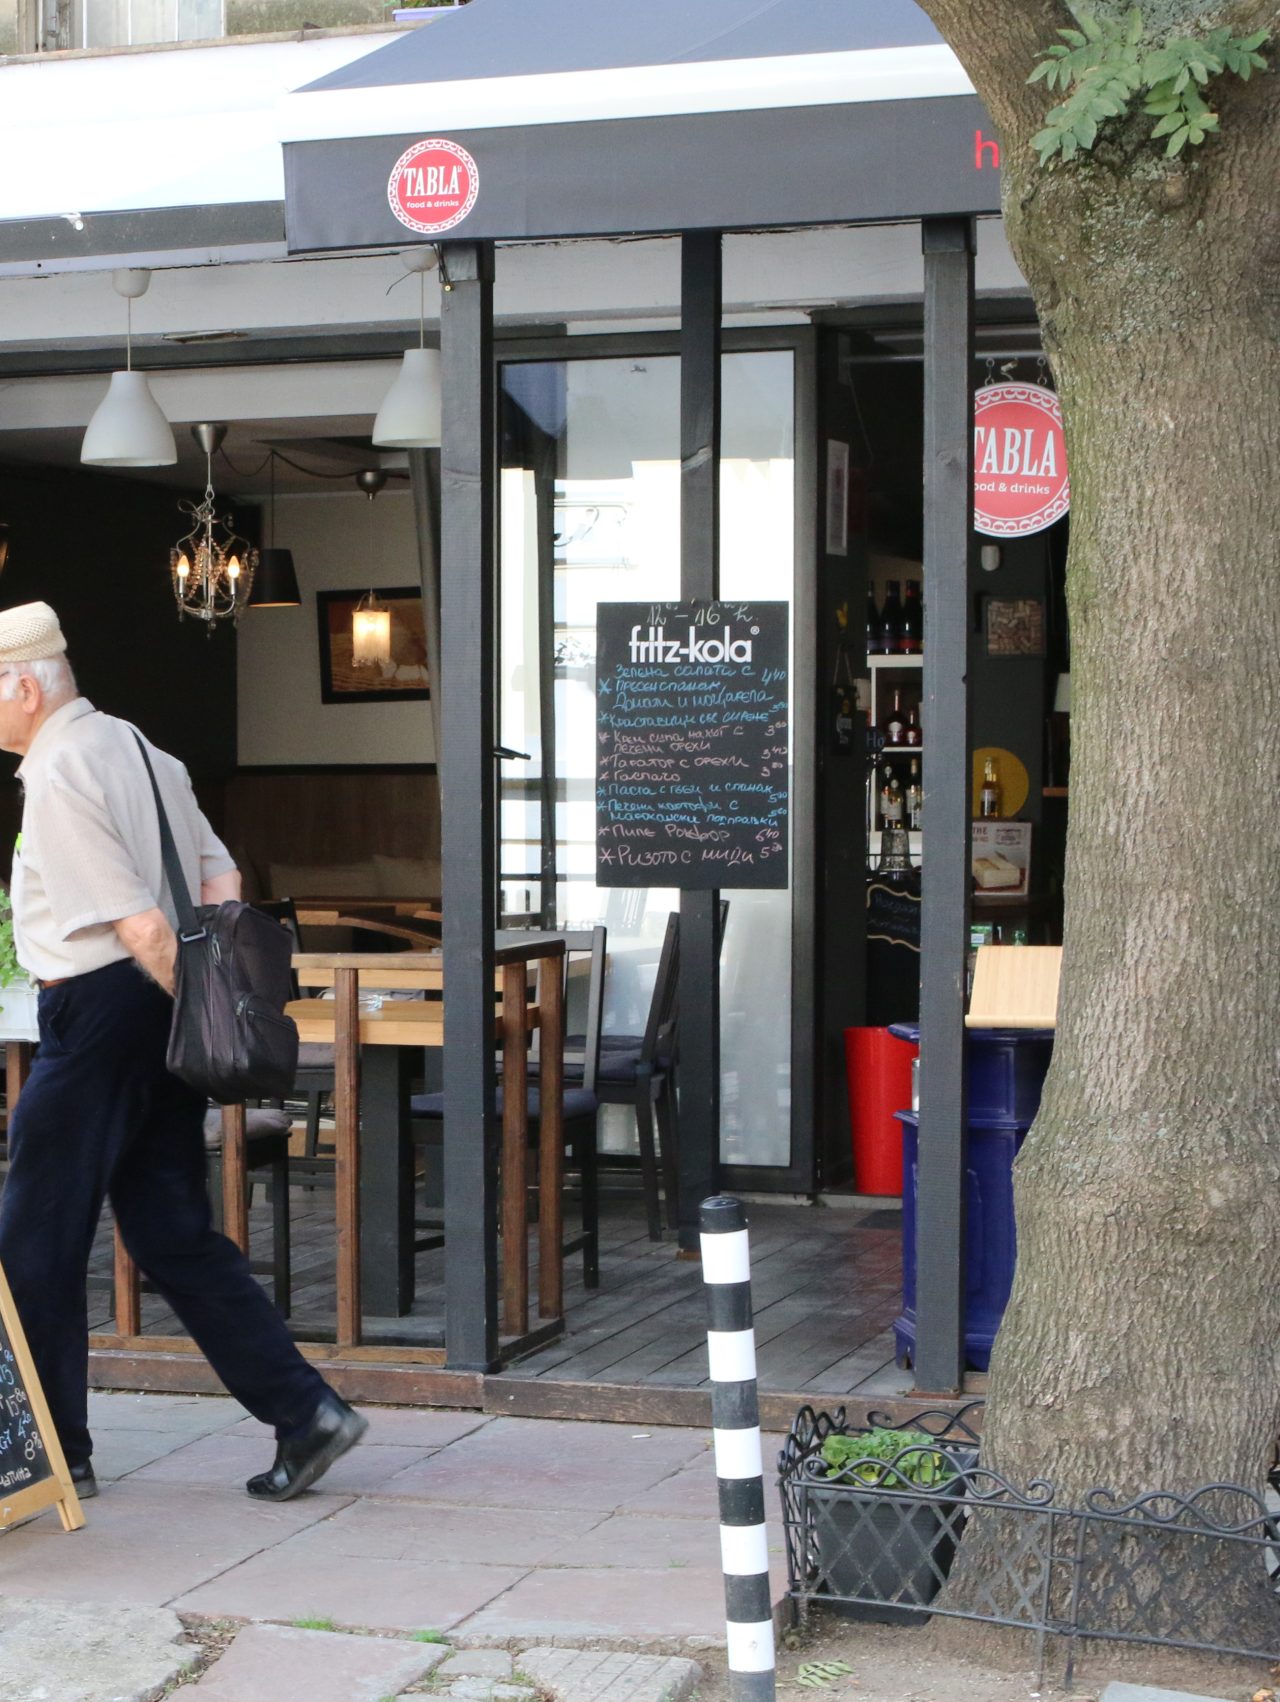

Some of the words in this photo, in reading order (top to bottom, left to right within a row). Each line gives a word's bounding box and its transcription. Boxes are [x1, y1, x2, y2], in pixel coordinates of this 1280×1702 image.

[403, 165, 460, 197] TABLA
[406, 201, 425, 209] food
[434, 199, 460, 208] drinks
[974, 481, 996, 492] ood
[1010, 482, 1050, 495] drinks
